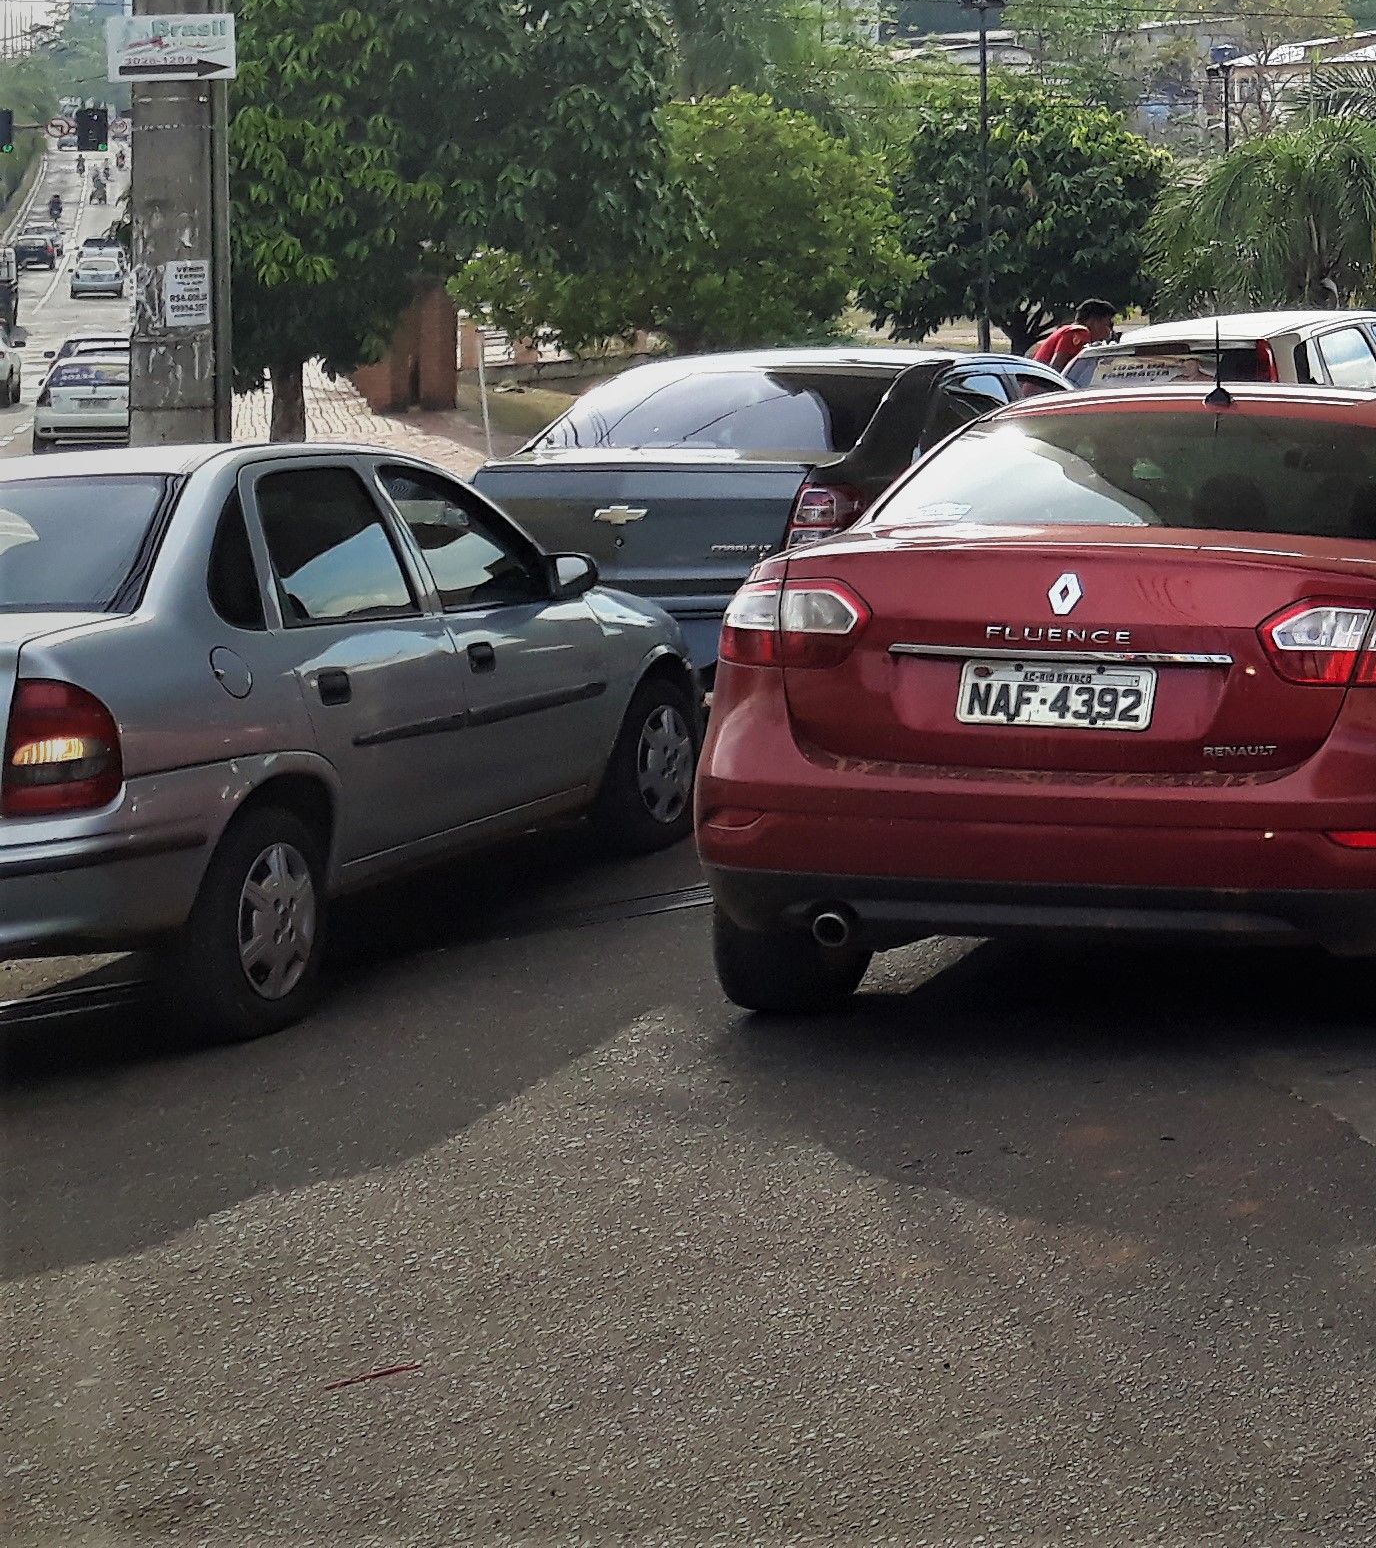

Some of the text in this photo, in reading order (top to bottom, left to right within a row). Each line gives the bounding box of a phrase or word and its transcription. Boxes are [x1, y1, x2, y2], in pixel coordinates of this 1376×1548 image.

[986, 626, 1131, 645] FLUENCE
[1056, 673, 1092, 685] BRANCO
[1203, 745, 1277, 756] RENAULT
